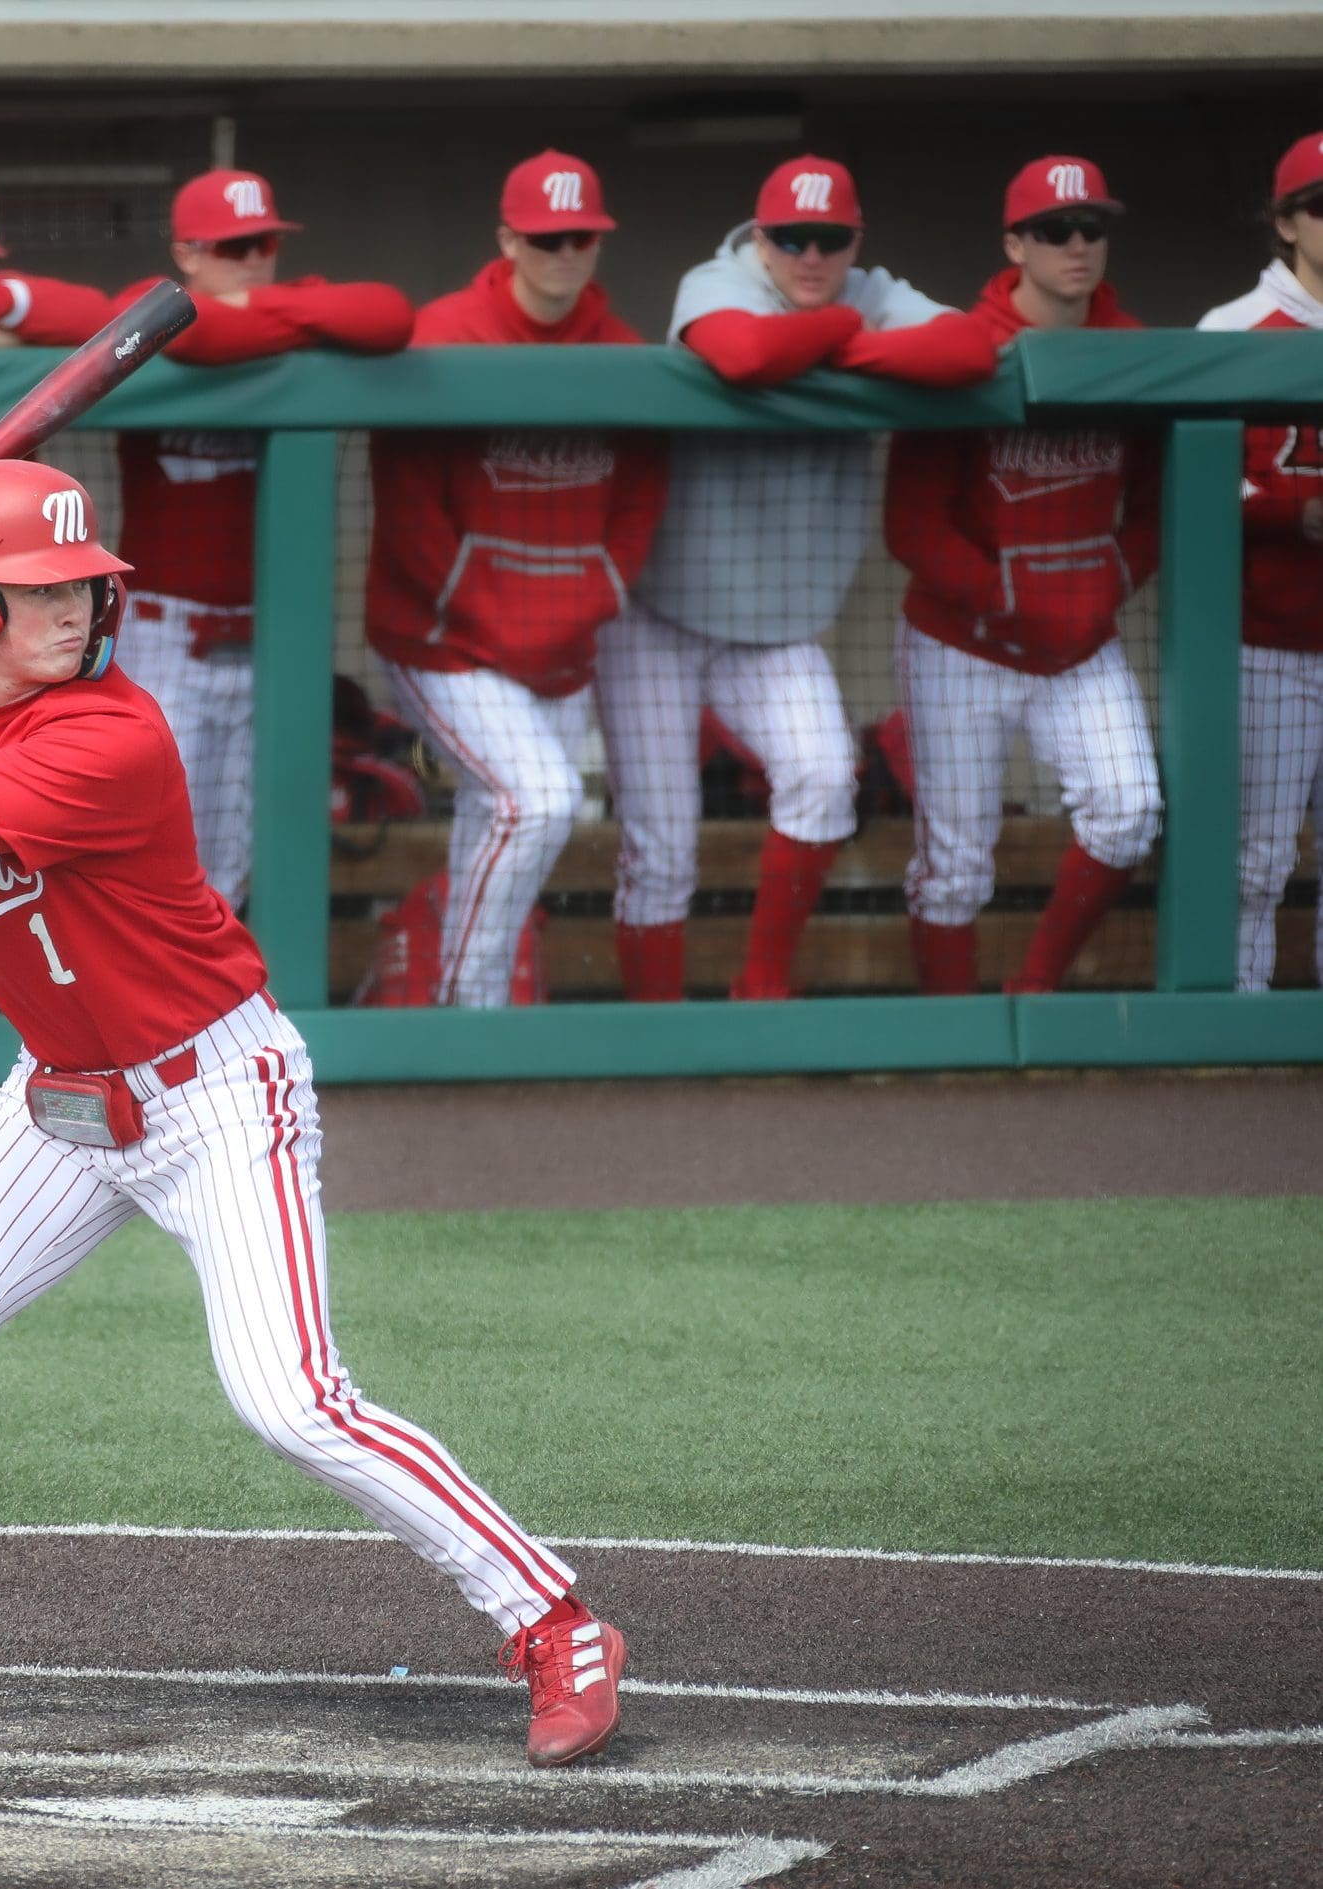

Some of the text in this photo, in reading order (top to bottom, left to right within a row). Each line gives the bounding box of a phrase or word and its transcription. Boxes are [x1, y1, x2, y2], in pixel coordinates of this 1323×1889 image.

[223, 180, 267, 218] M
[542, 171, 583, 212] M
[790, 172, 833, 213] M
[1046, 164, 1089, 201] M
[41, 489, 88, 545] M
[28, 912, 77, 986] 1
